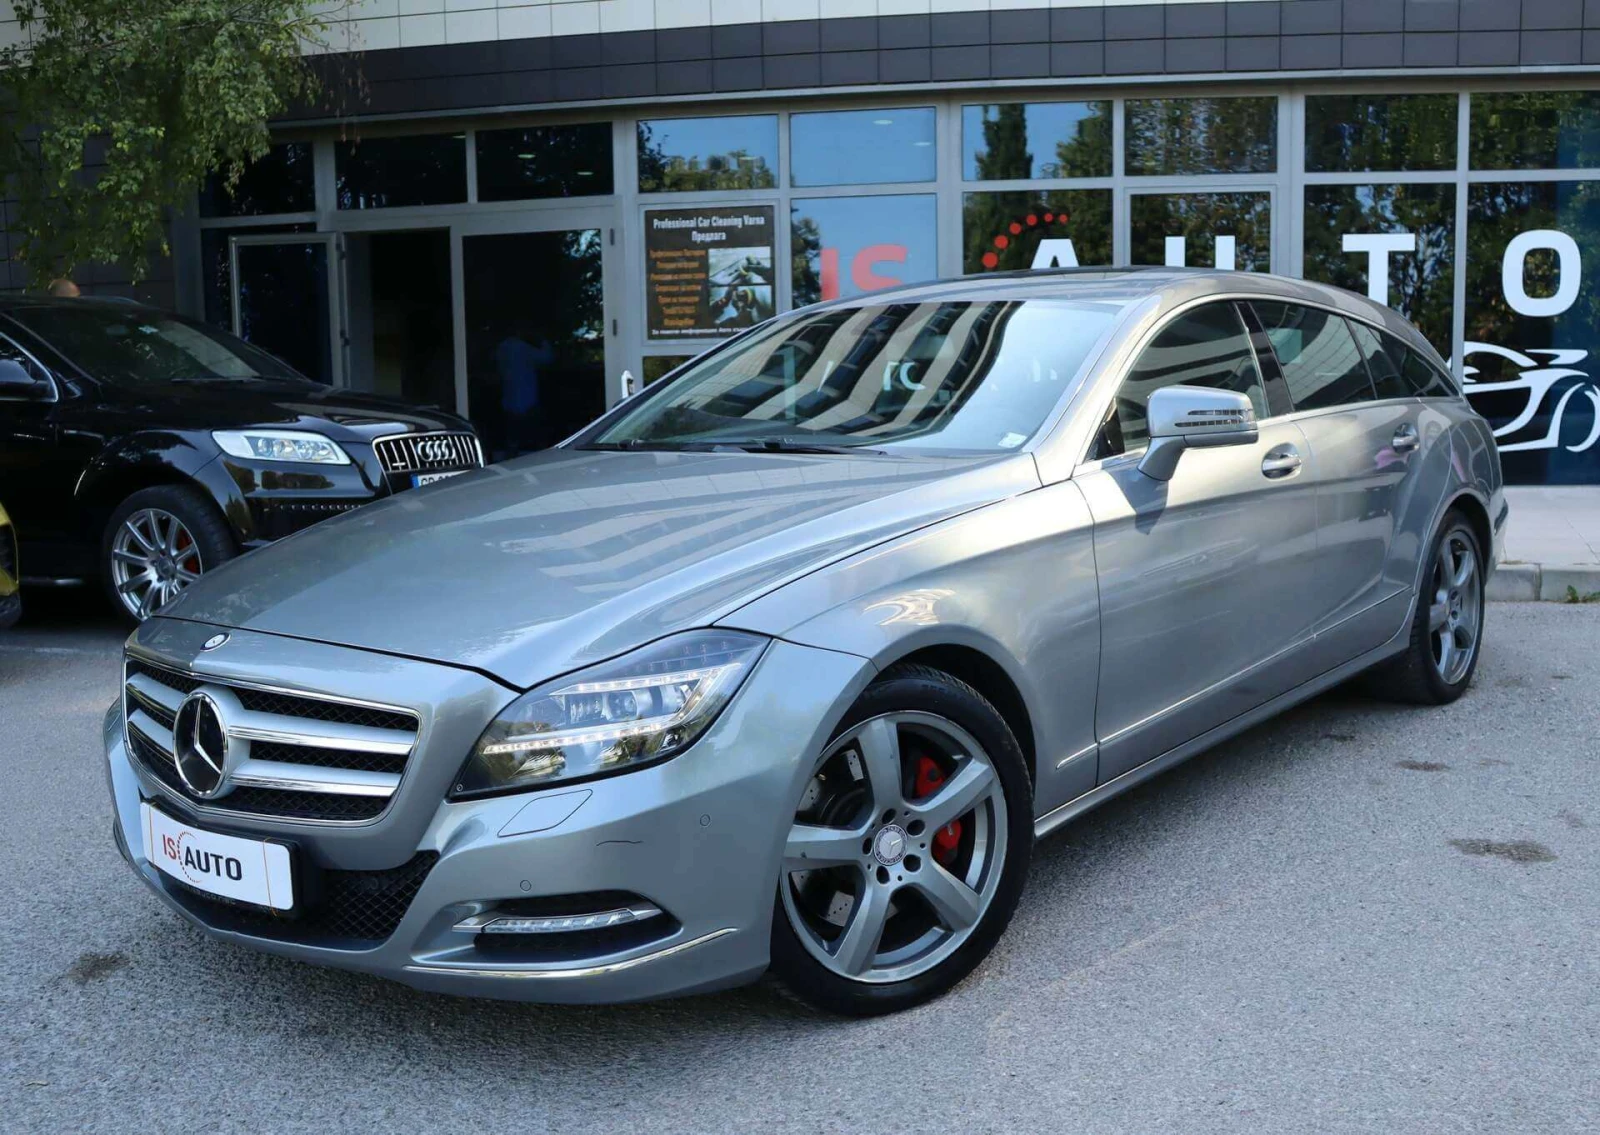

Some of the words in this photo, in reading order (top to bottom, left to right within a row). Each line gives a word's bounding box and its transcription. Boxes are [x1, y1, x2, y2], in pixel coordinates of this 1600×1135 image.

[653, 217, 697, 229] Professional
[698, 216, 711, 227] Car
[711, 214, 743, 228] Cleaning
[743, 214, 765, 226] Varna
[162, 834, 177, 860] IS
[184, 846, 243, 881] AUTO
